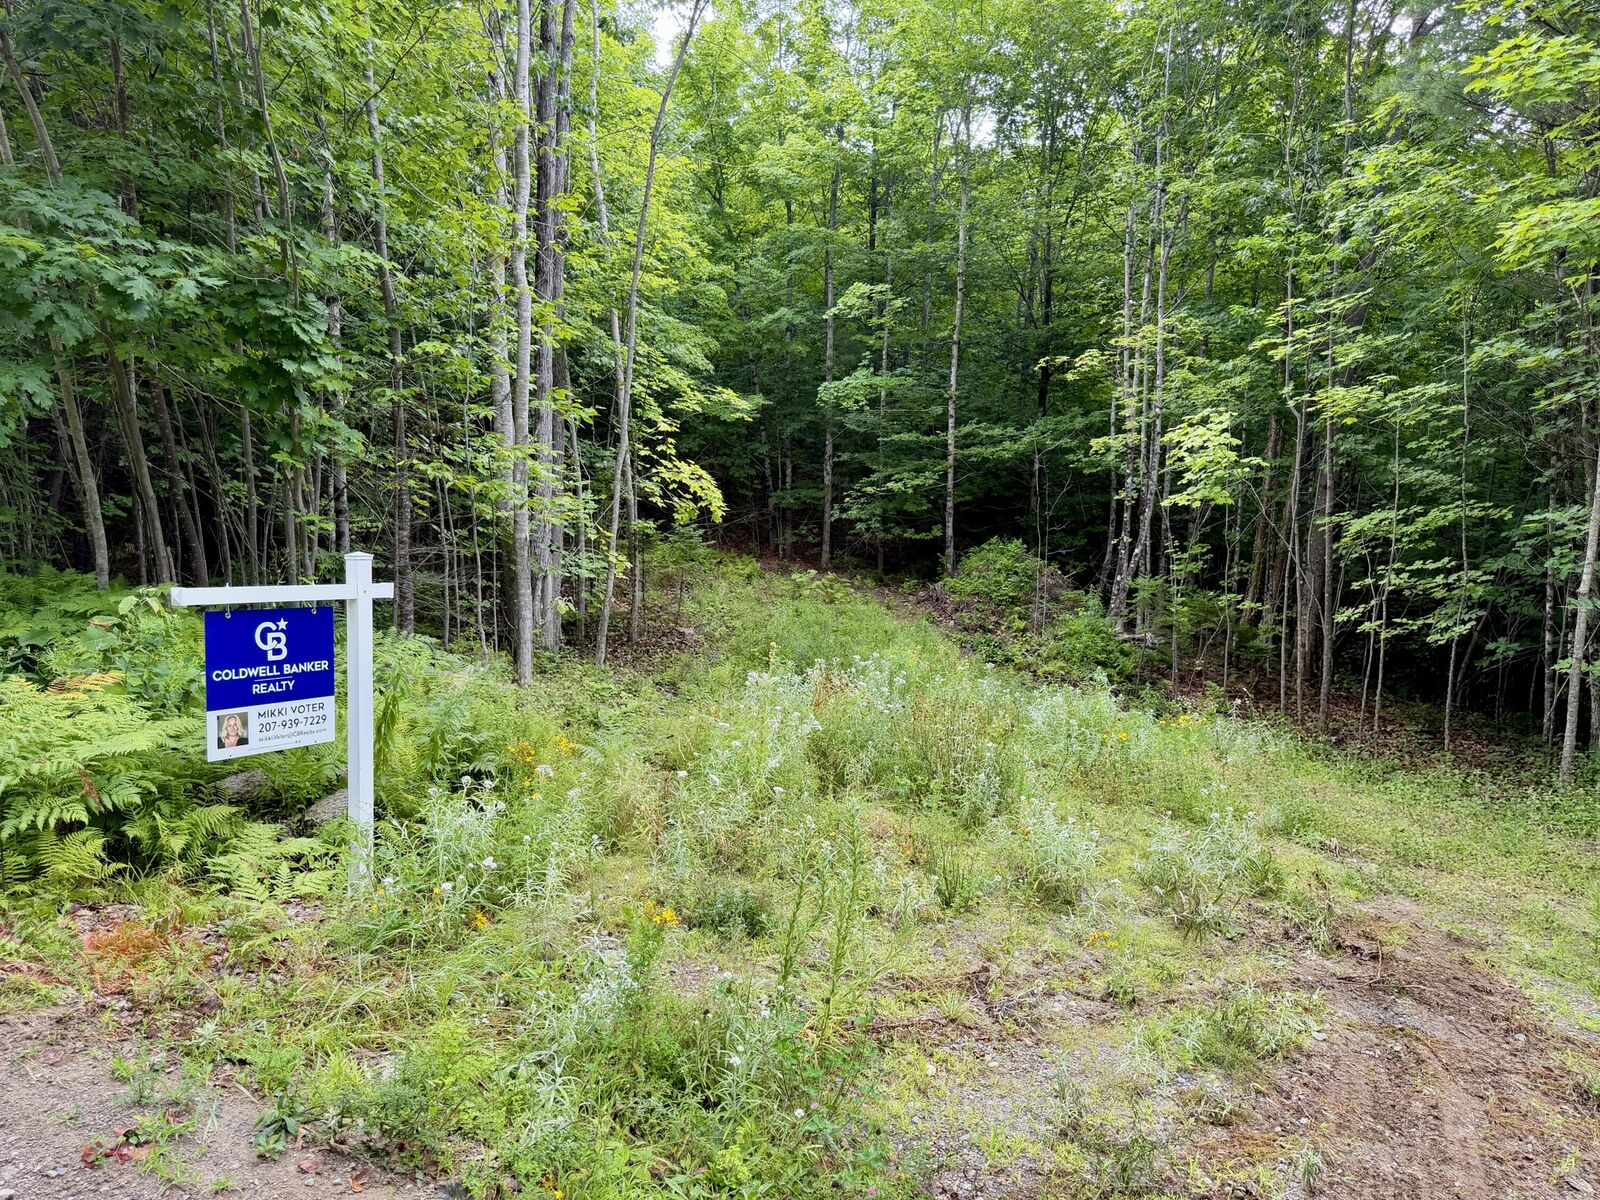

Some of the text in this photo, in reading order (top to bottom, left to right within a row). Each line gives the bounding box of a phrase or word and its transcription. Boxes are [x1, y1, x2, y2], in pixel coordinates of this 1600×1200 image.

[254, 621, 288, 661] CB
[212, 660, 329, 681] COLDWELL BANKER
[252, 680, 295, 695] REALTY
[257, 702, 325, 719] MIKKI VOTER
[258, 714, 327, 733] 207-939-7229
